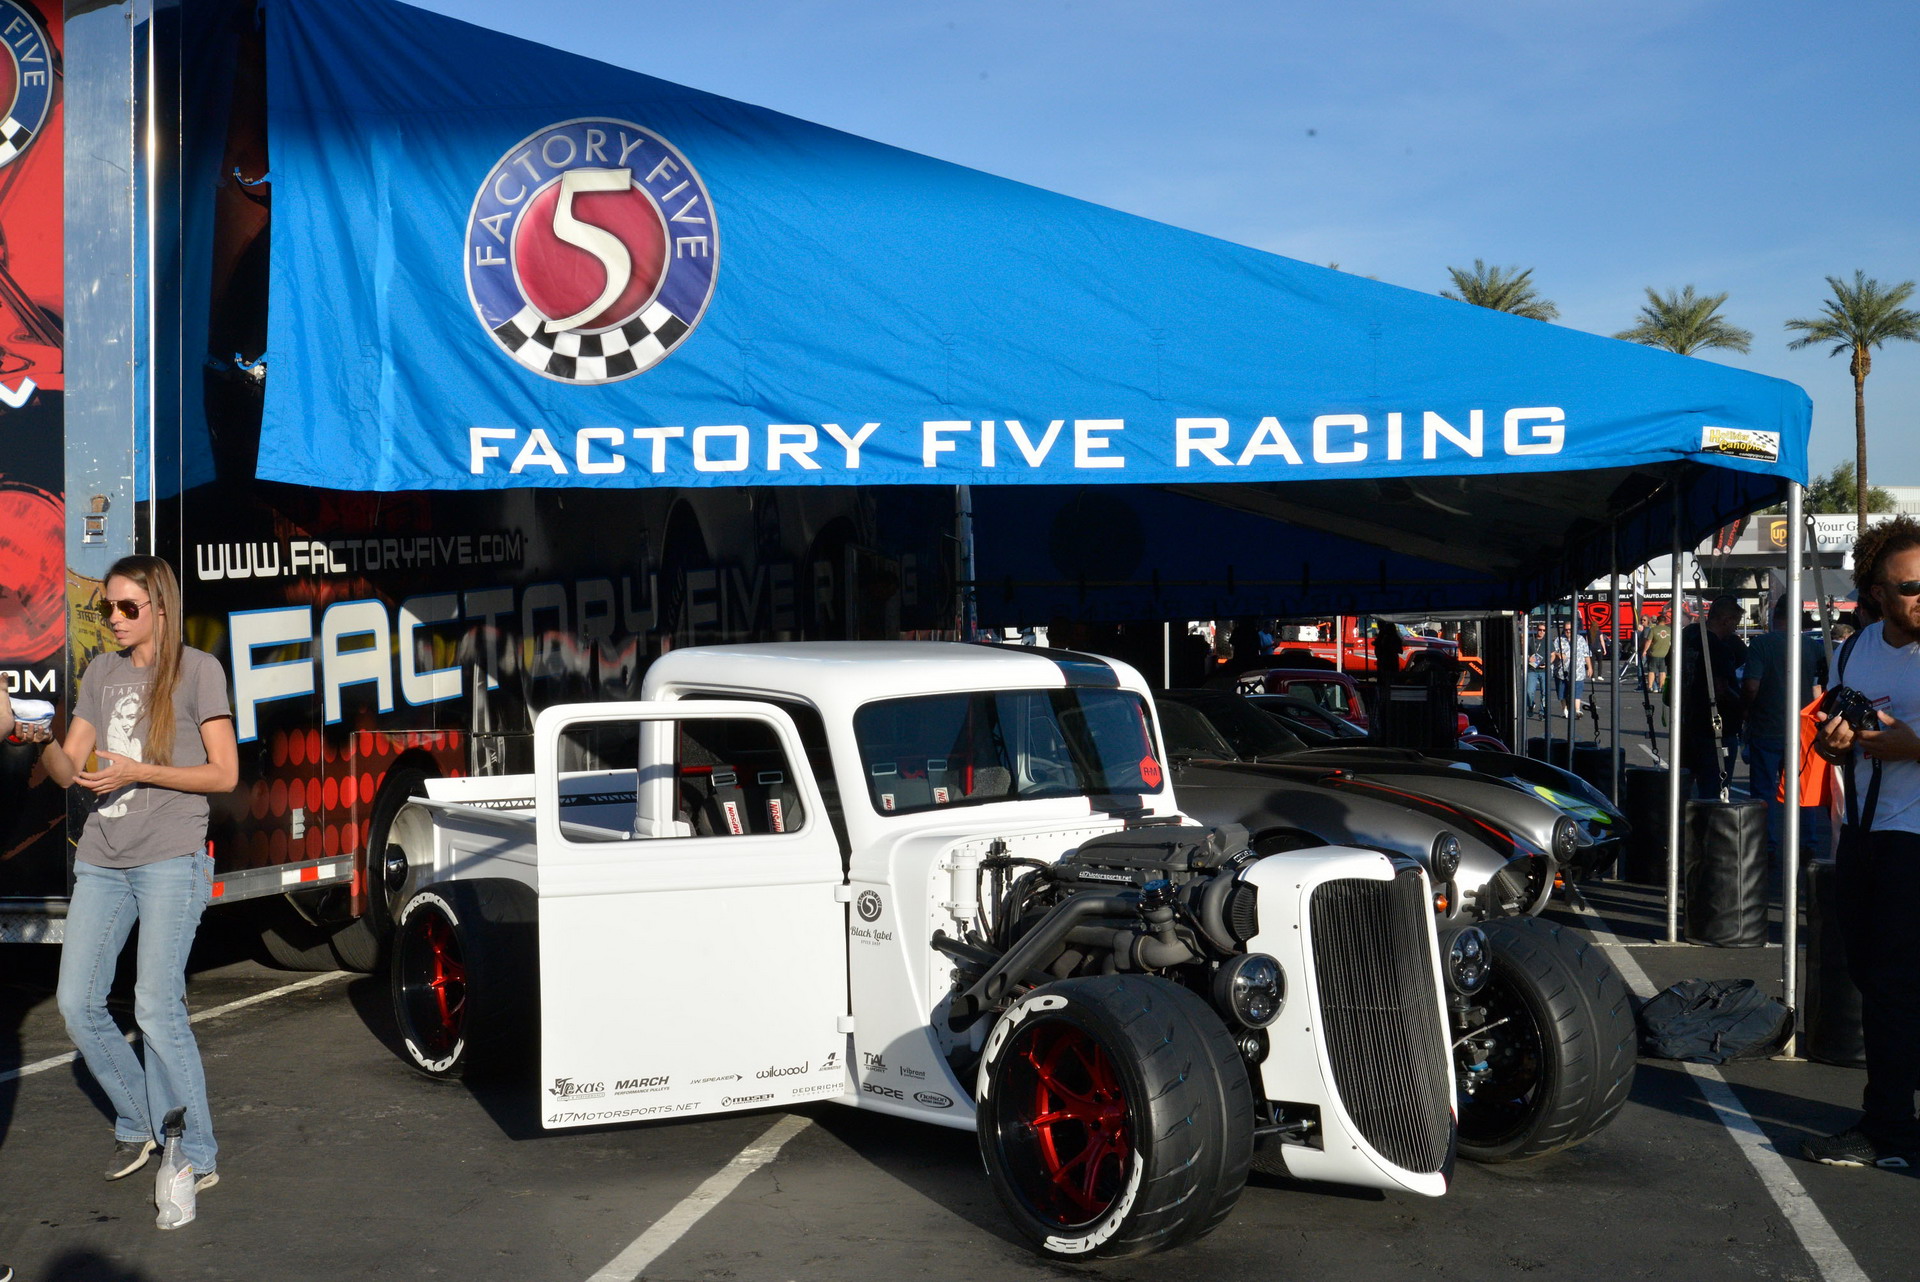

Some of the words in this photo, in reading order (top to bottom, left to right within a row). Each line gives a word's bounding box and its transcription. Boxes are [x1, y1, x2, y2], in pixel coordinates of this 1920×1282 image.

[4, 16, 45, 87] FIVE
[476, 129, 644, 266] FACTORY
[646, 156, 709, 259] FIVE
[544, 168, 632, 334] 5
[469, 421, 882, 476] FACTORY
[921, 417, 1126, 470] FIVE
[1174, 406, 1567, 468] RACING
[1817, 522, 1844, 533] Your
[1817, 534, 1841, 545] Our
[196, 532, 522, 581] WWW.FACTORYFIVE.COM
[229, 572, 658, 743] FACTORY
[850, 925, 872, 939] Black
[873, 929, 892, 942] Label
[976, 994, 1069, 1104] TOYO
[755, 1061, 809, 1079] wilwood
[902, 1067, 926, 1077] vibrant
[559, 1077, 605, 1097] Texas
[614, 1076, 670, 1090] MARCH
[792, 1082, 844, 1095] DEDERICHS
[547, 1101, 701, 1124] 417MOTORSPORTS.NET
[1043, 1148, 1144, 1256] PROXES
